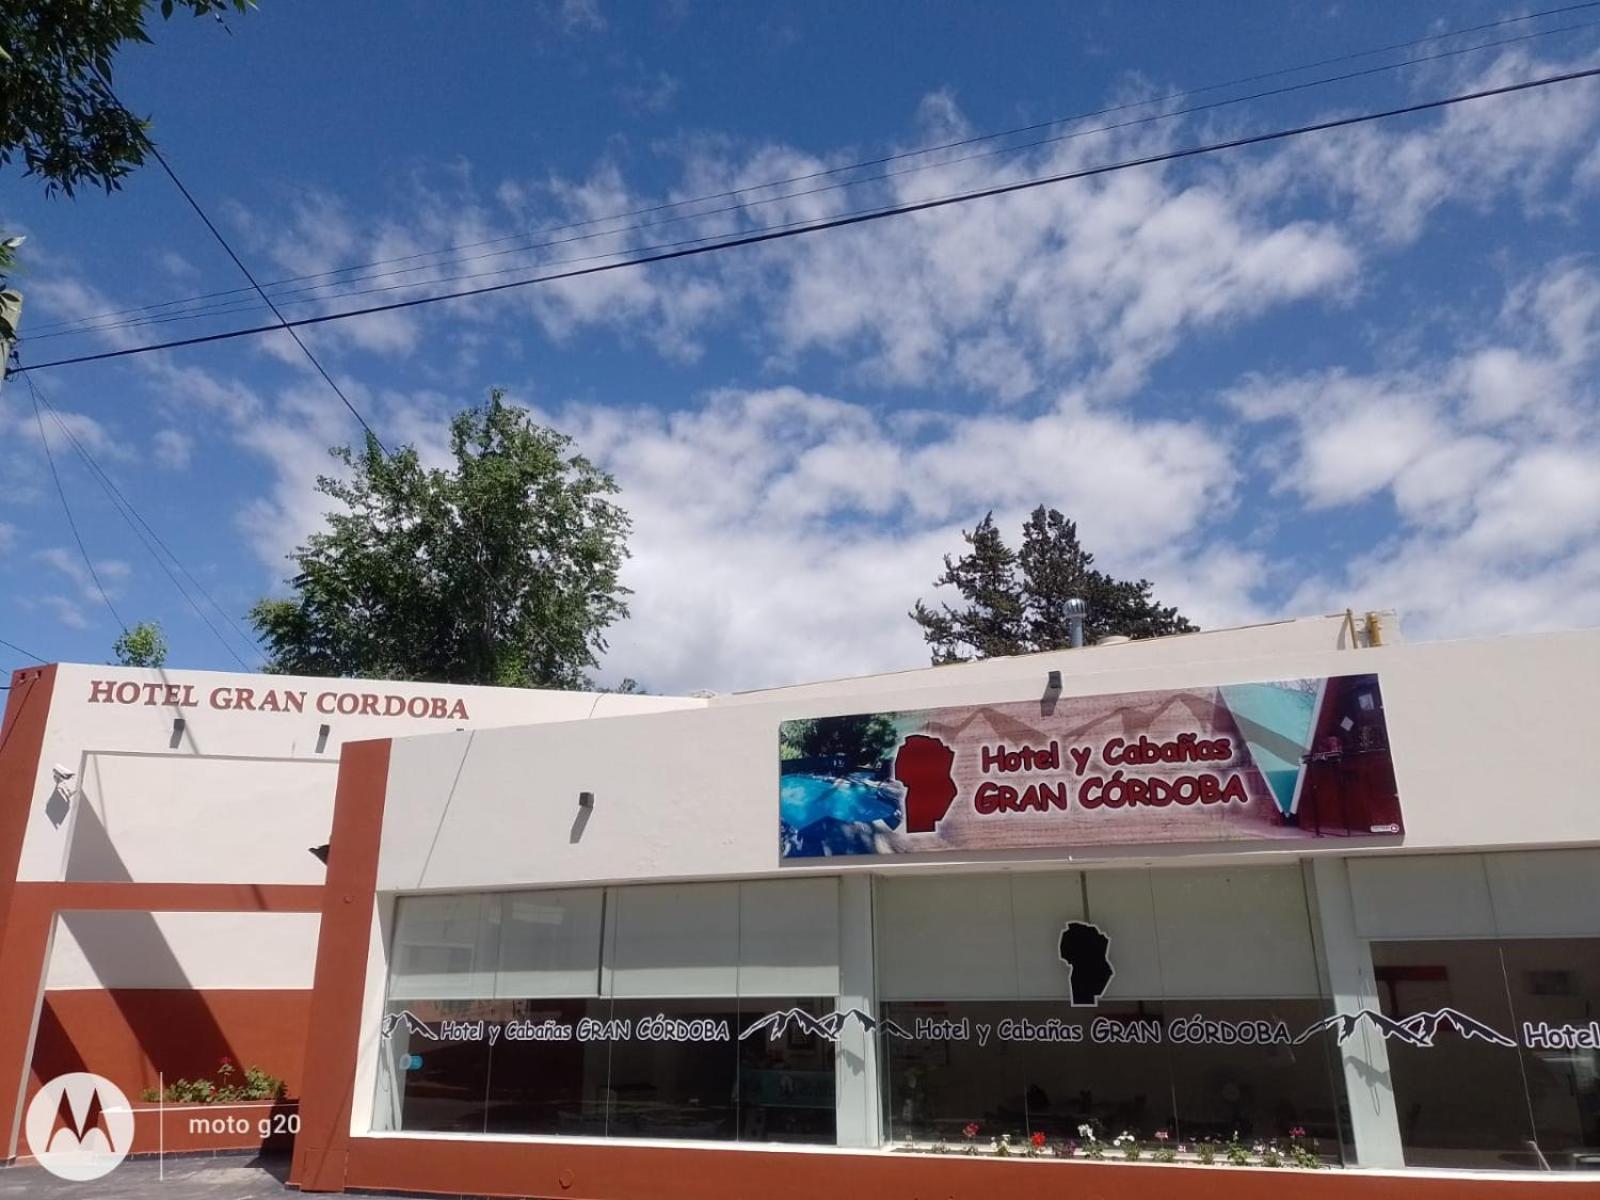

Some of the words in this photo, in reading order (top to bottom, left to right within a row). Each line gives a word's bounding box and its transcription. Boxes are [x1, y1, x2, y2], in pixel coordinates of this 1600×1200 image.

[88, 680, 198, 707] HOTEL
[209, 687, 305, 714] GRAN
[316, 692, 469, 720] CORDOBA
[981, 740, 1060, 774] Hotel
[1070, 746, 1092, 776] y
[1102, 732, 1234, 767] Cabañas
[974, 781, 1068, 815] GRAN
[1078, 769, 1249, 809] CÓRDOBA
[440, 1020, 484, 1041] Hotel
[488, 1024, 502, 1046] y
[504, 1019, 572, 1041] Cabañas
[575, 1016, 631, 1041] GRAN
[635, 1013, 730, 1042] CÓRDOBA
[915, 1017, 970, 1041] Hotel
[976, 1023, 991, 1046] y
[998, 1018, 1083, 1042] Cabañas
[1090, 1017, 1161, 1044] GRAN
[1167, 1014, 1292, 1045] CÓRDOBA
[1522, 1021, 1600, 1049] Hotel
